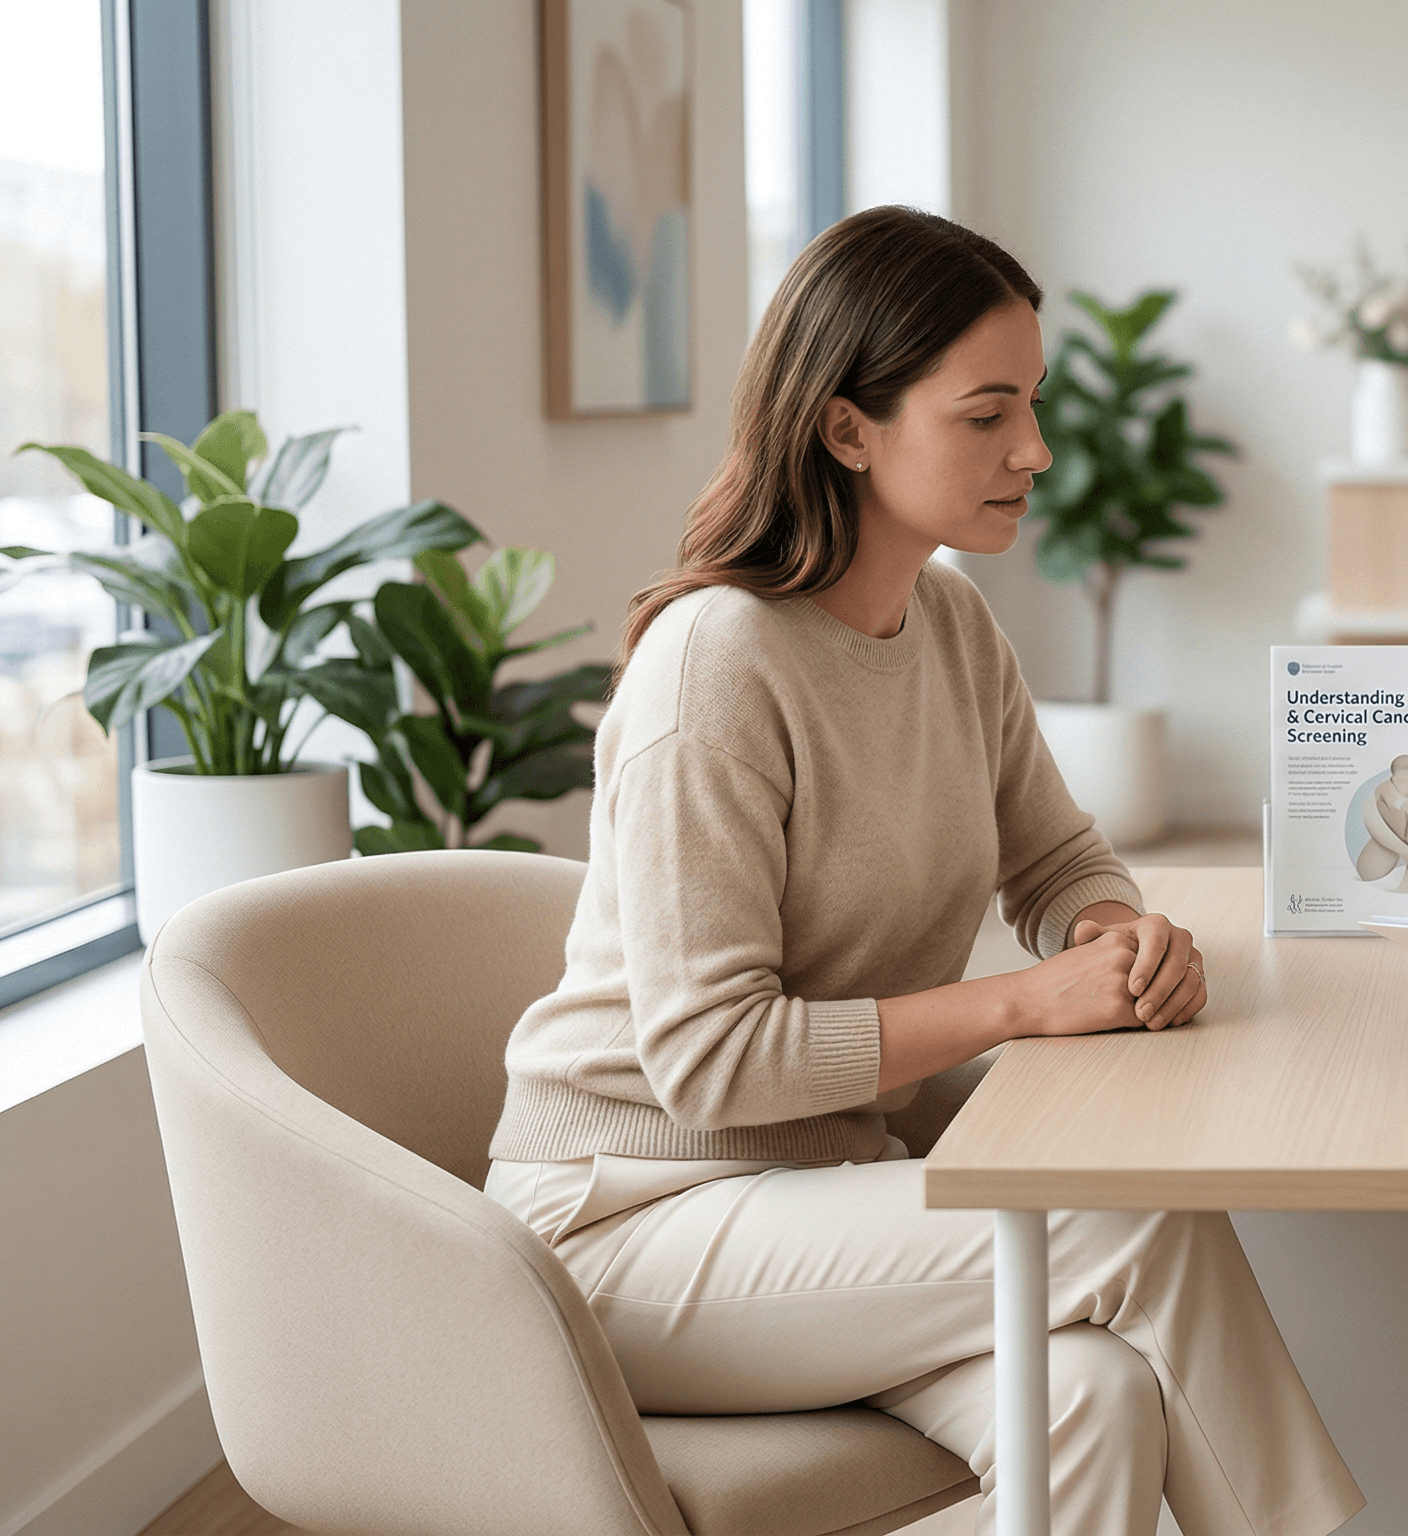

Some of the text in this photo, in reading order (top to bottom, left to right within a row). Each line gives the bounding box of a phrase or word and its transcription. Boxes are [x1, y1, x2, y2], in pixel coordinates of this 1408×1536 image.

[1287, 690, 1404, 708] Understanding
[1287, 709, 1299, 724] &
[1303, 709, 1368, 724] Cervical
[1287, 728, 1367, 746] Screening
